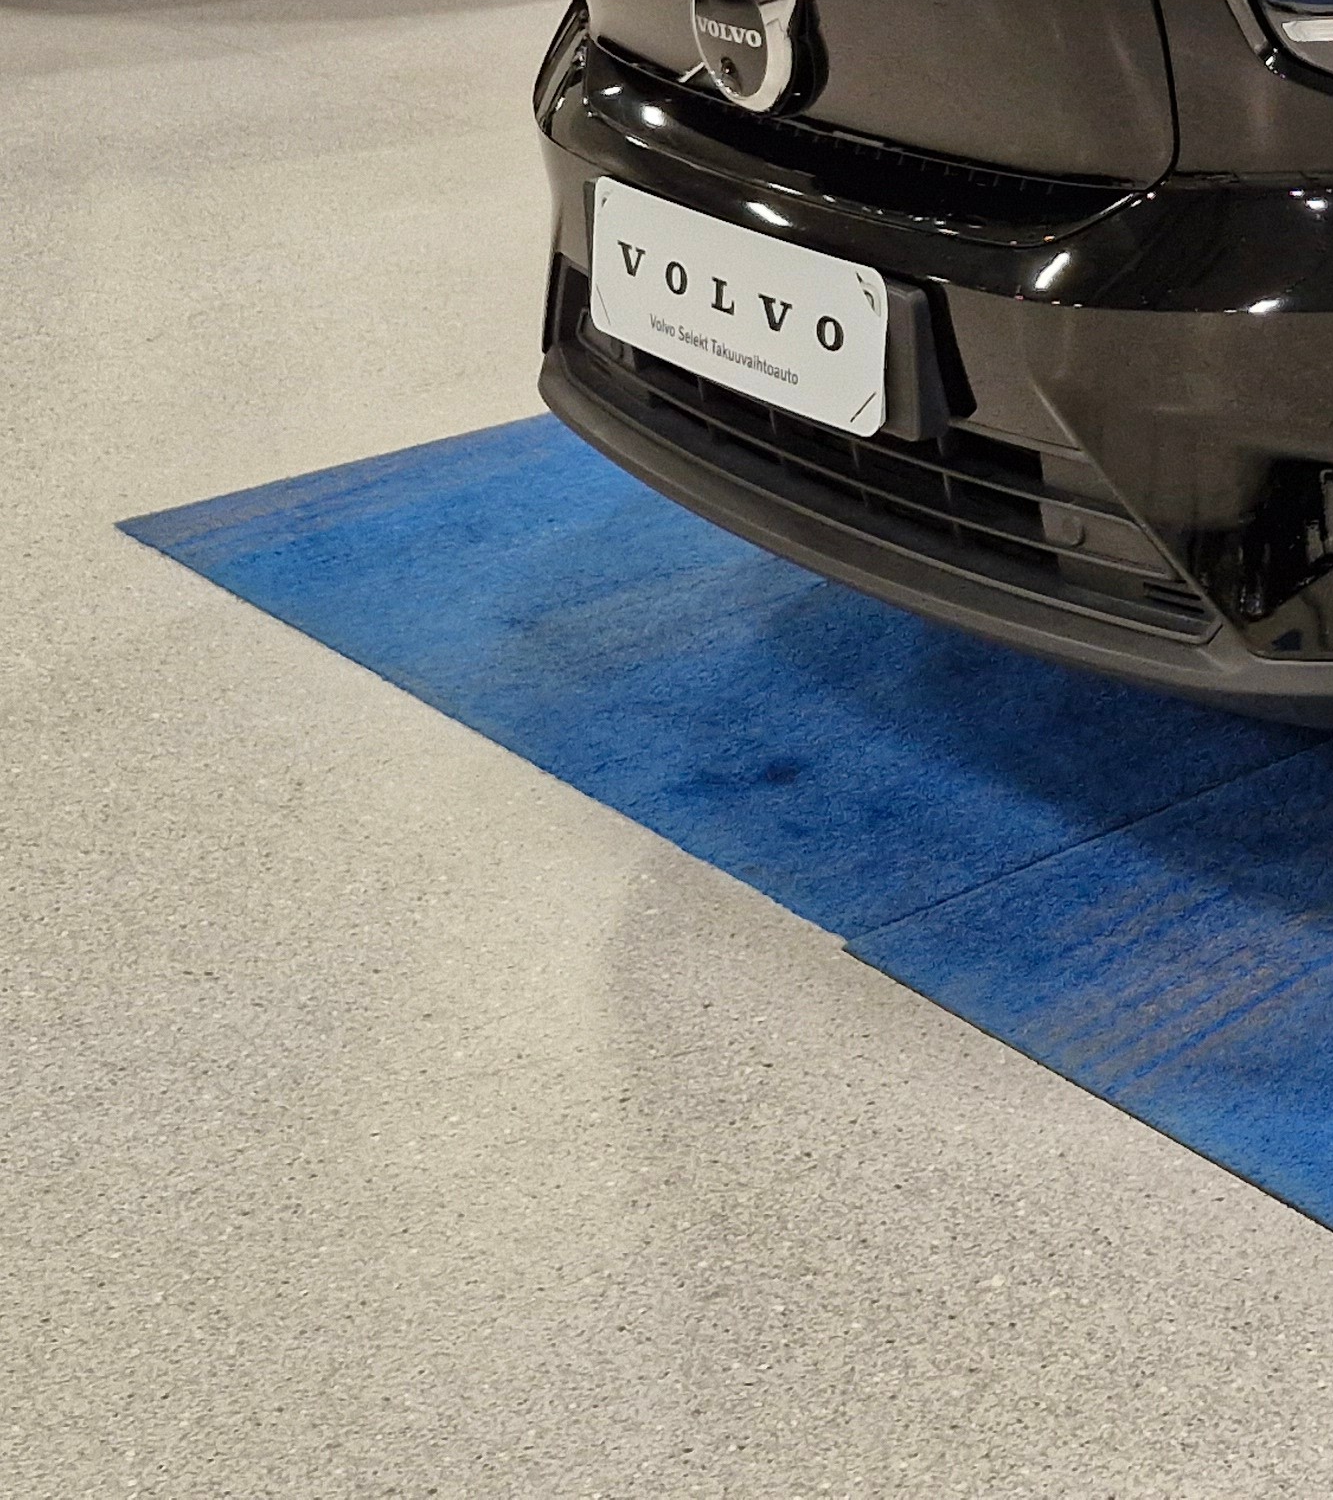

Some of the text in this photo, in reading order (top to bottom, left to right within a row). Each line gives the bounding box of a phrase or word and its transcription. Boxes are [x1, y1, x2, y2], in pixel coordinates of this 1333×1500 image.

[695, 14, 762, 48] VOLVO
[617, 239, 845, 352] VOLVO
[649, 313, 800, 386] Volvo Selekt Takuuvaihtoauto
